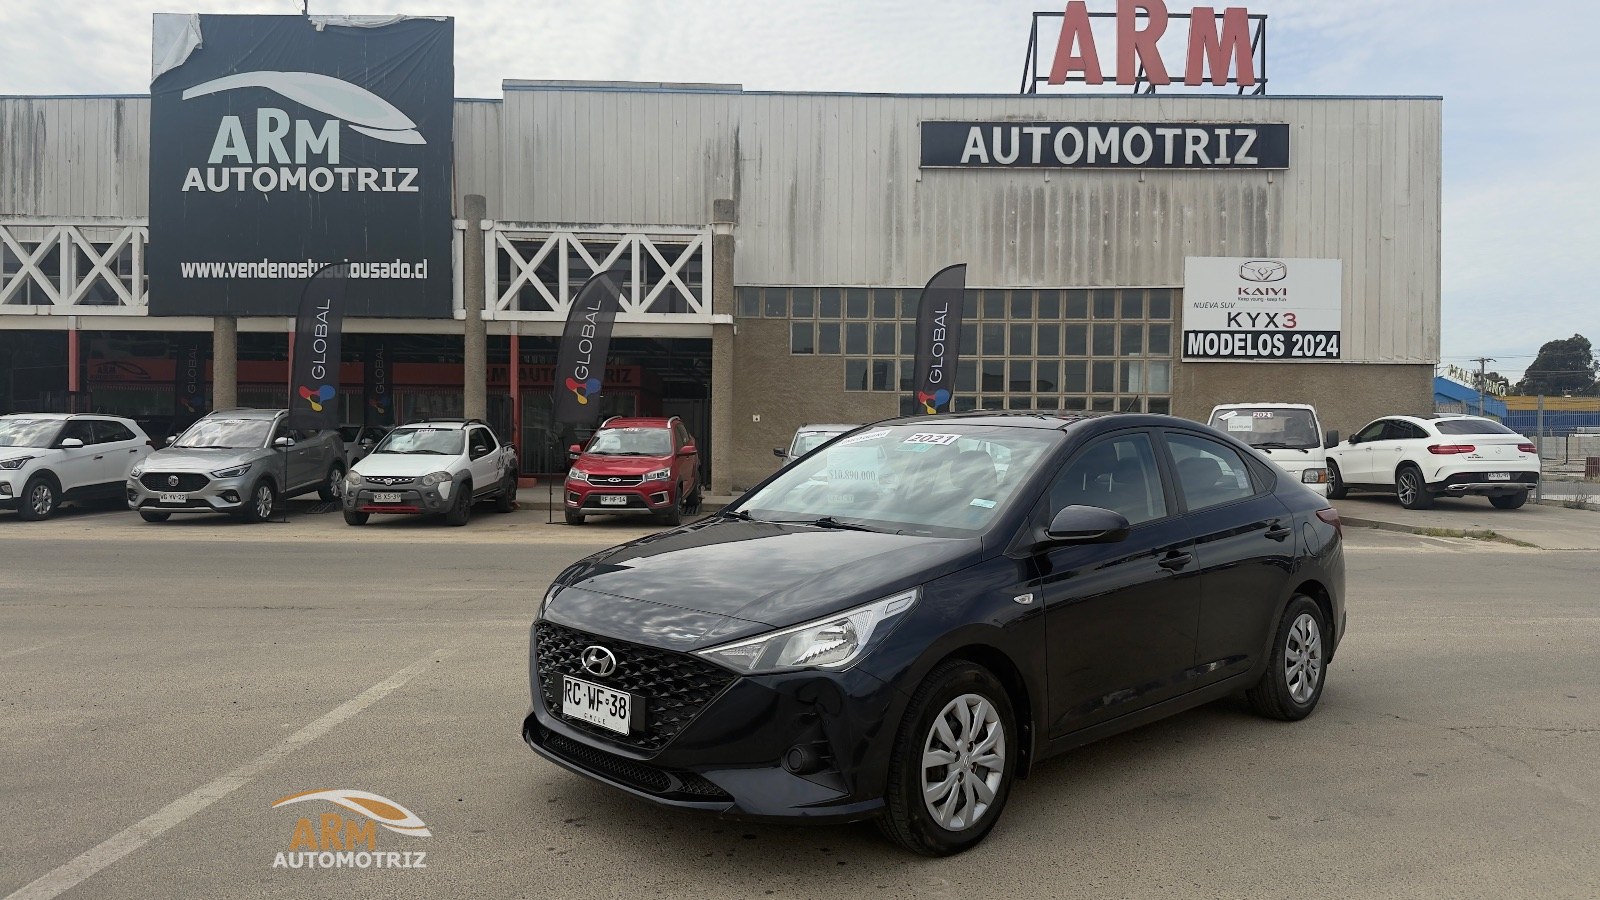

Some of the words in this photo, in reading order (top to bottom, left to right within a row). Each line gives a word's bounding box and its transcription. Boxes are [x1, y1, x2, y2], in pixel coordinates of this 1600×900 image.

[1047, 0, 1255, 86] ARM
[207, 108, 340, 165] ARM
[960, 125, 1258, 165] AUTOMOTRIZ
[181, 166, 419, 192] AUTOMOTRIZ
[311, 298, 331, 380] GLOBAL
[573, 300, 602, 380] GLOBAL
[928, 302, 949, 384] GLOBAL
[1227, 311, 1298, 329] KYX3
[1187, 332, 1286, 356] MODELOS
[1291, 333, 1339, 357] 2024
[906, 433, 953, 444] 2021
